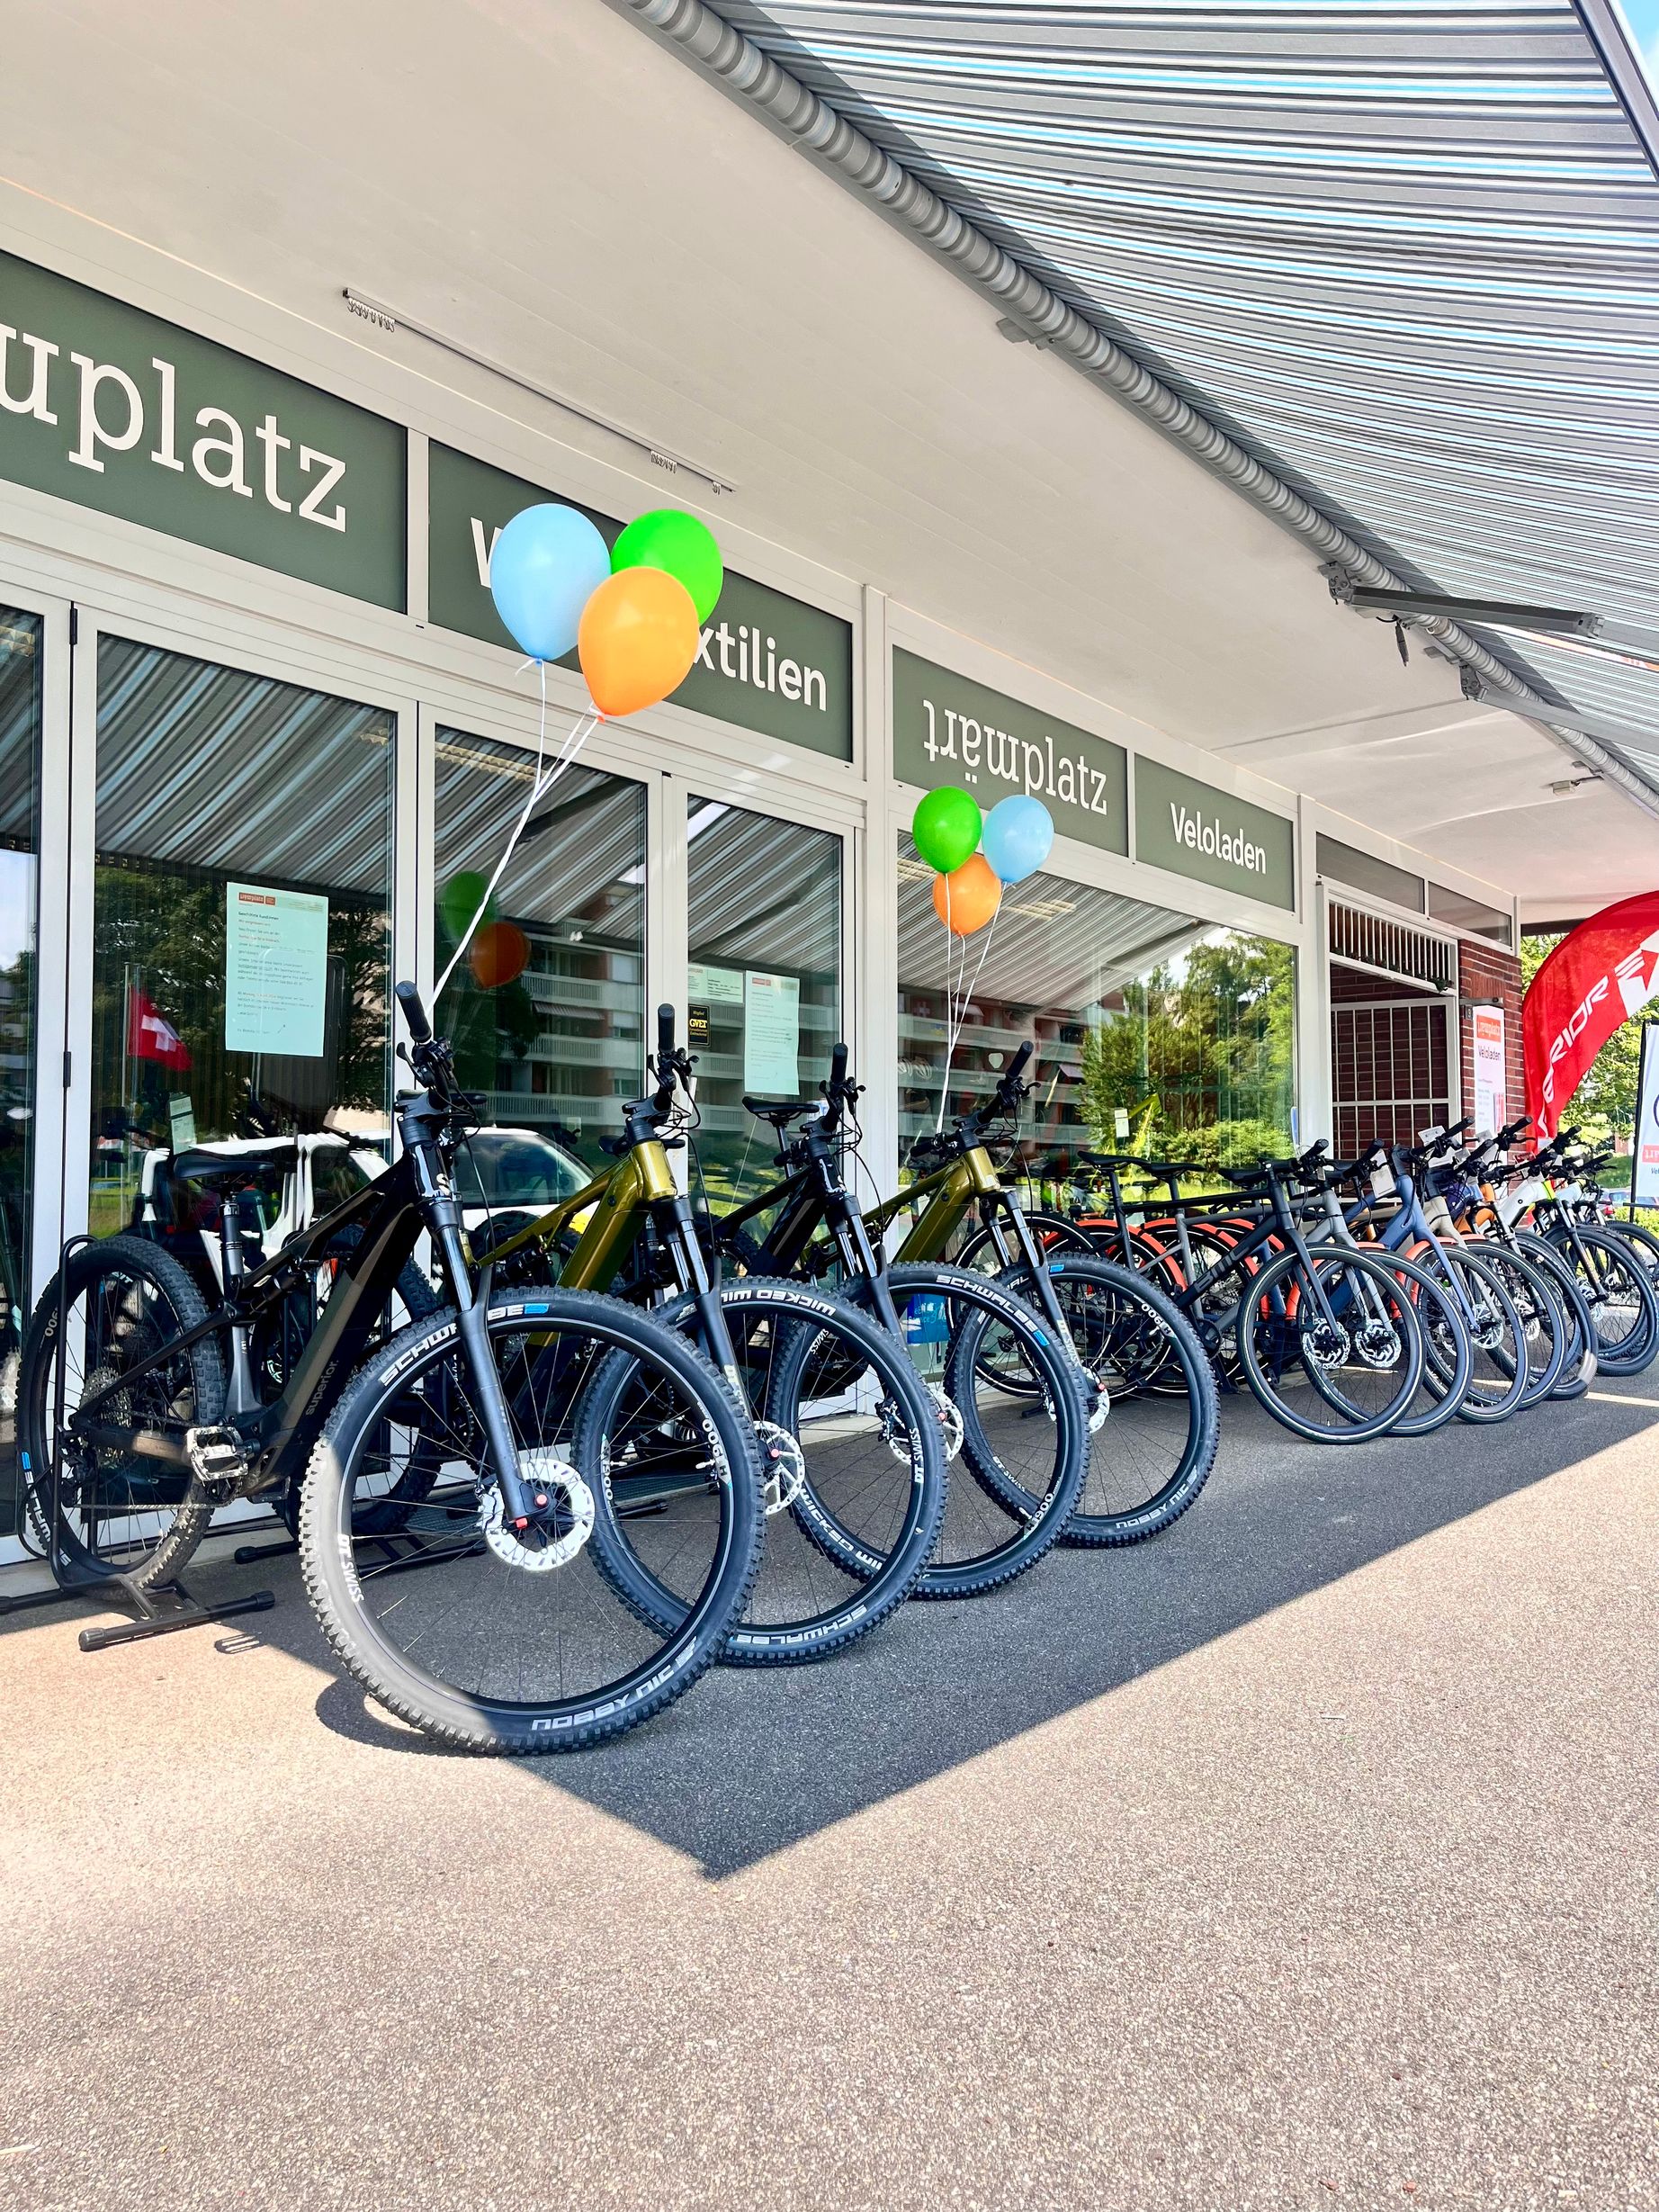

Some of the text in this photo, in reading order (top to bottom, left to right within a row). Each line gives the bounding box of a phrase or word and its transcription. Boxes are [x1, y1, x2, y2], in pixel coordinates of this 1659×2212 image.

[1169, 802, 1267, 875] Veloladen
[1477, 1044, 1502, 1061] Veloladen
[756, 1290, 837, 1317] WICKED
[936, 1274, 1038, 1333] SCHWALBE
[909, 1427, 924, 1461] SWISS
[1003, 1470, 1026, 1492] SWISS
[1116, 1483, 1190, 1529] NOBBY NIC
[340, 1561, 364, 1603] SWISS
[736, 1604, 868, 1645] SCHWALBE
[531, 1664, 675, 1731] NOBBY NIC
